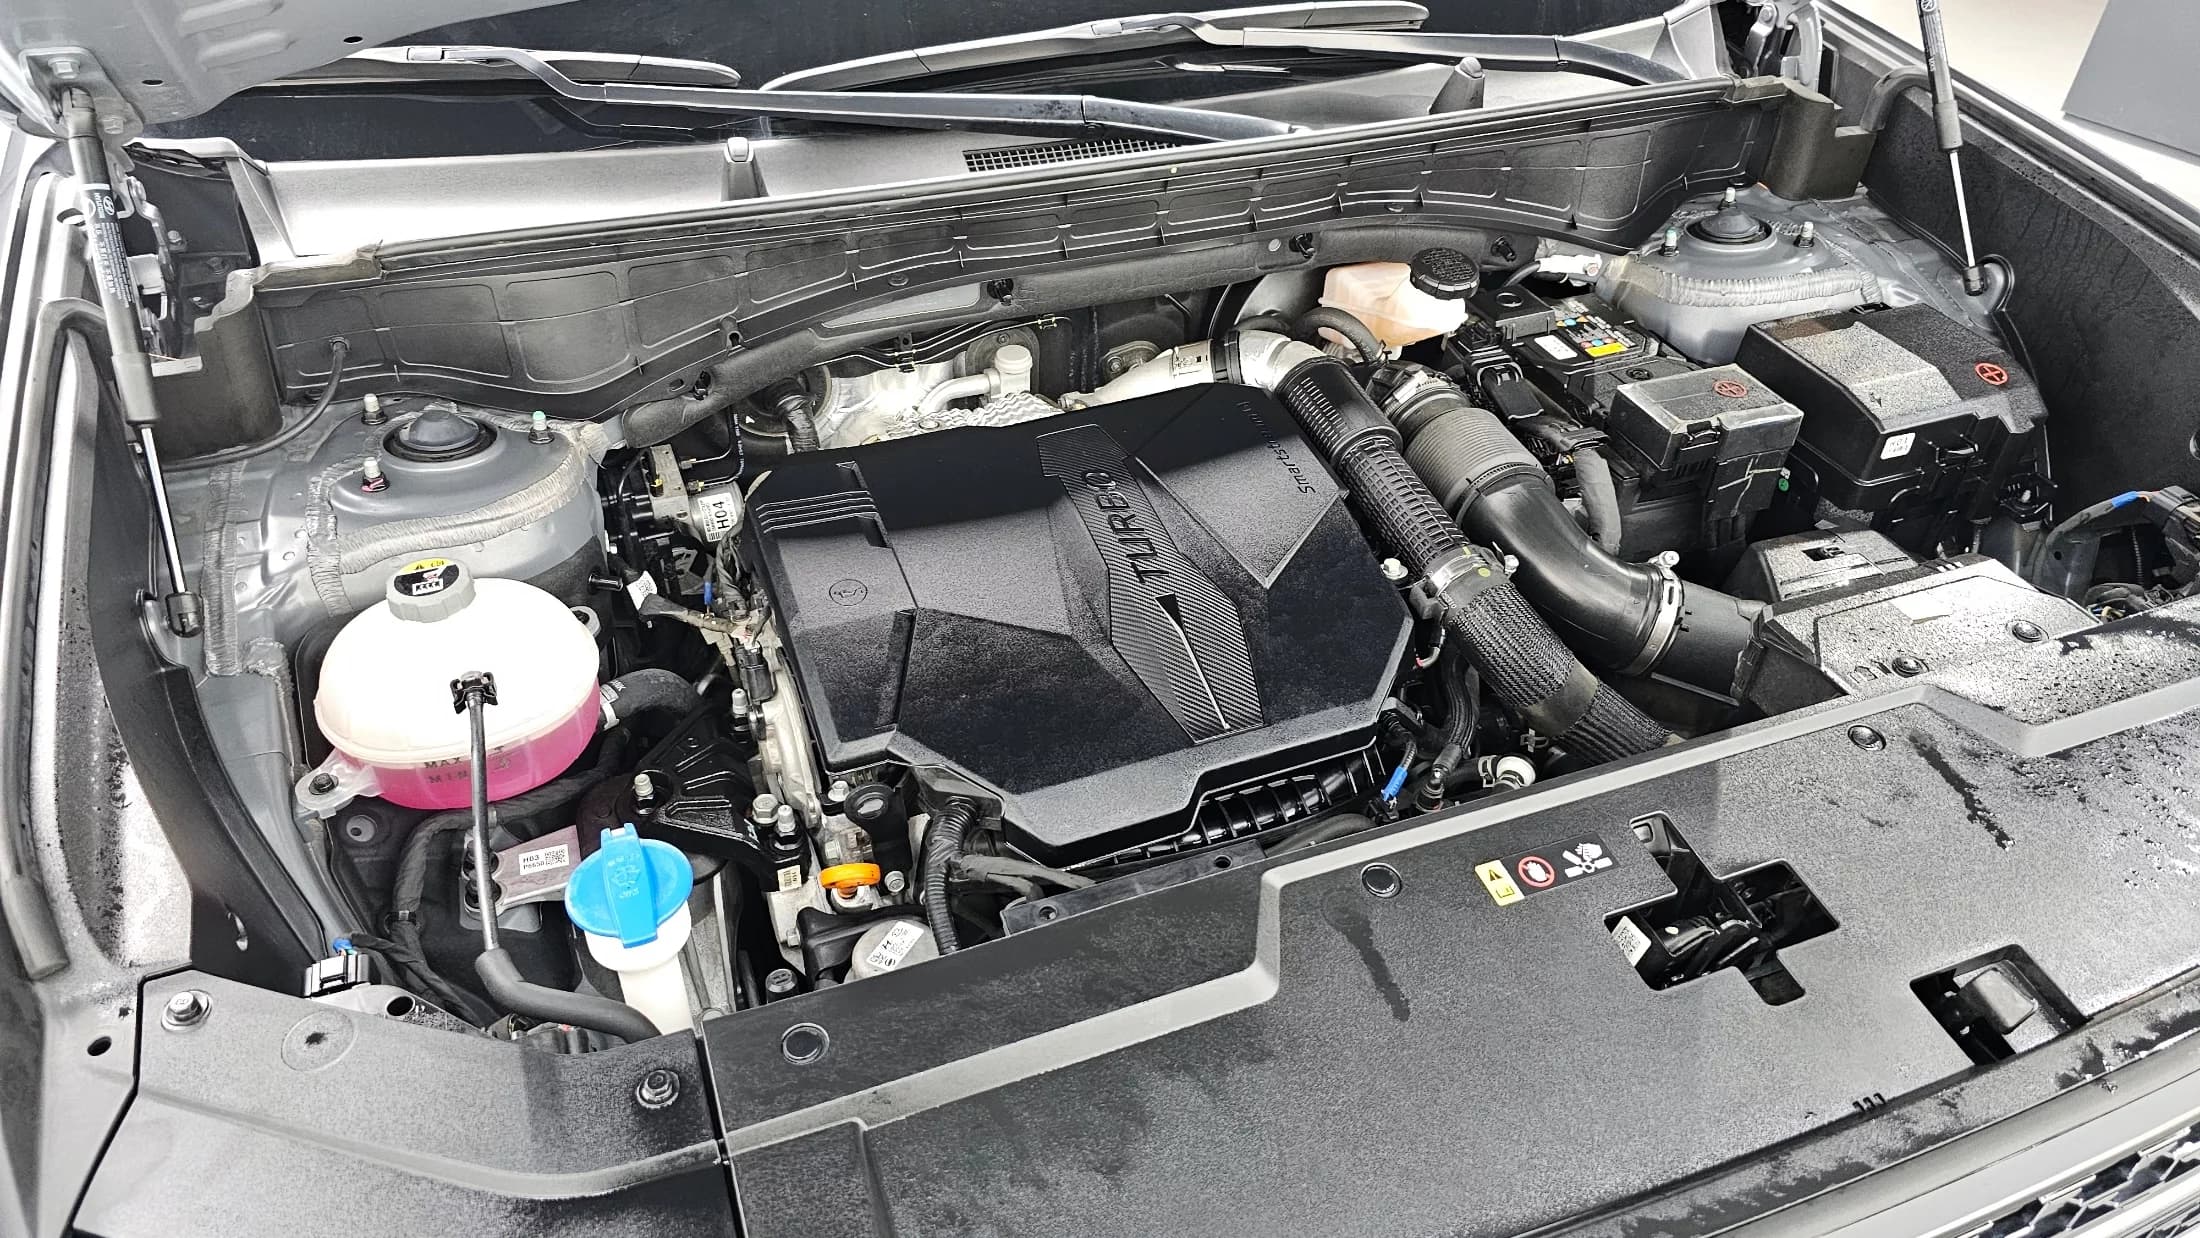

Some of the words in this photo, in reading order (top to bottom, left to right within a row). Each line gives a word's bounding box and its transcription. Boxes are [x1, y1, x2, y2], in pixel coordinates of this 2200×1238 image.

[712, 500, 730, 530] H04
[1081, 470, 1169, 585] TURBO
[423, 757, 463, 769] MAX
